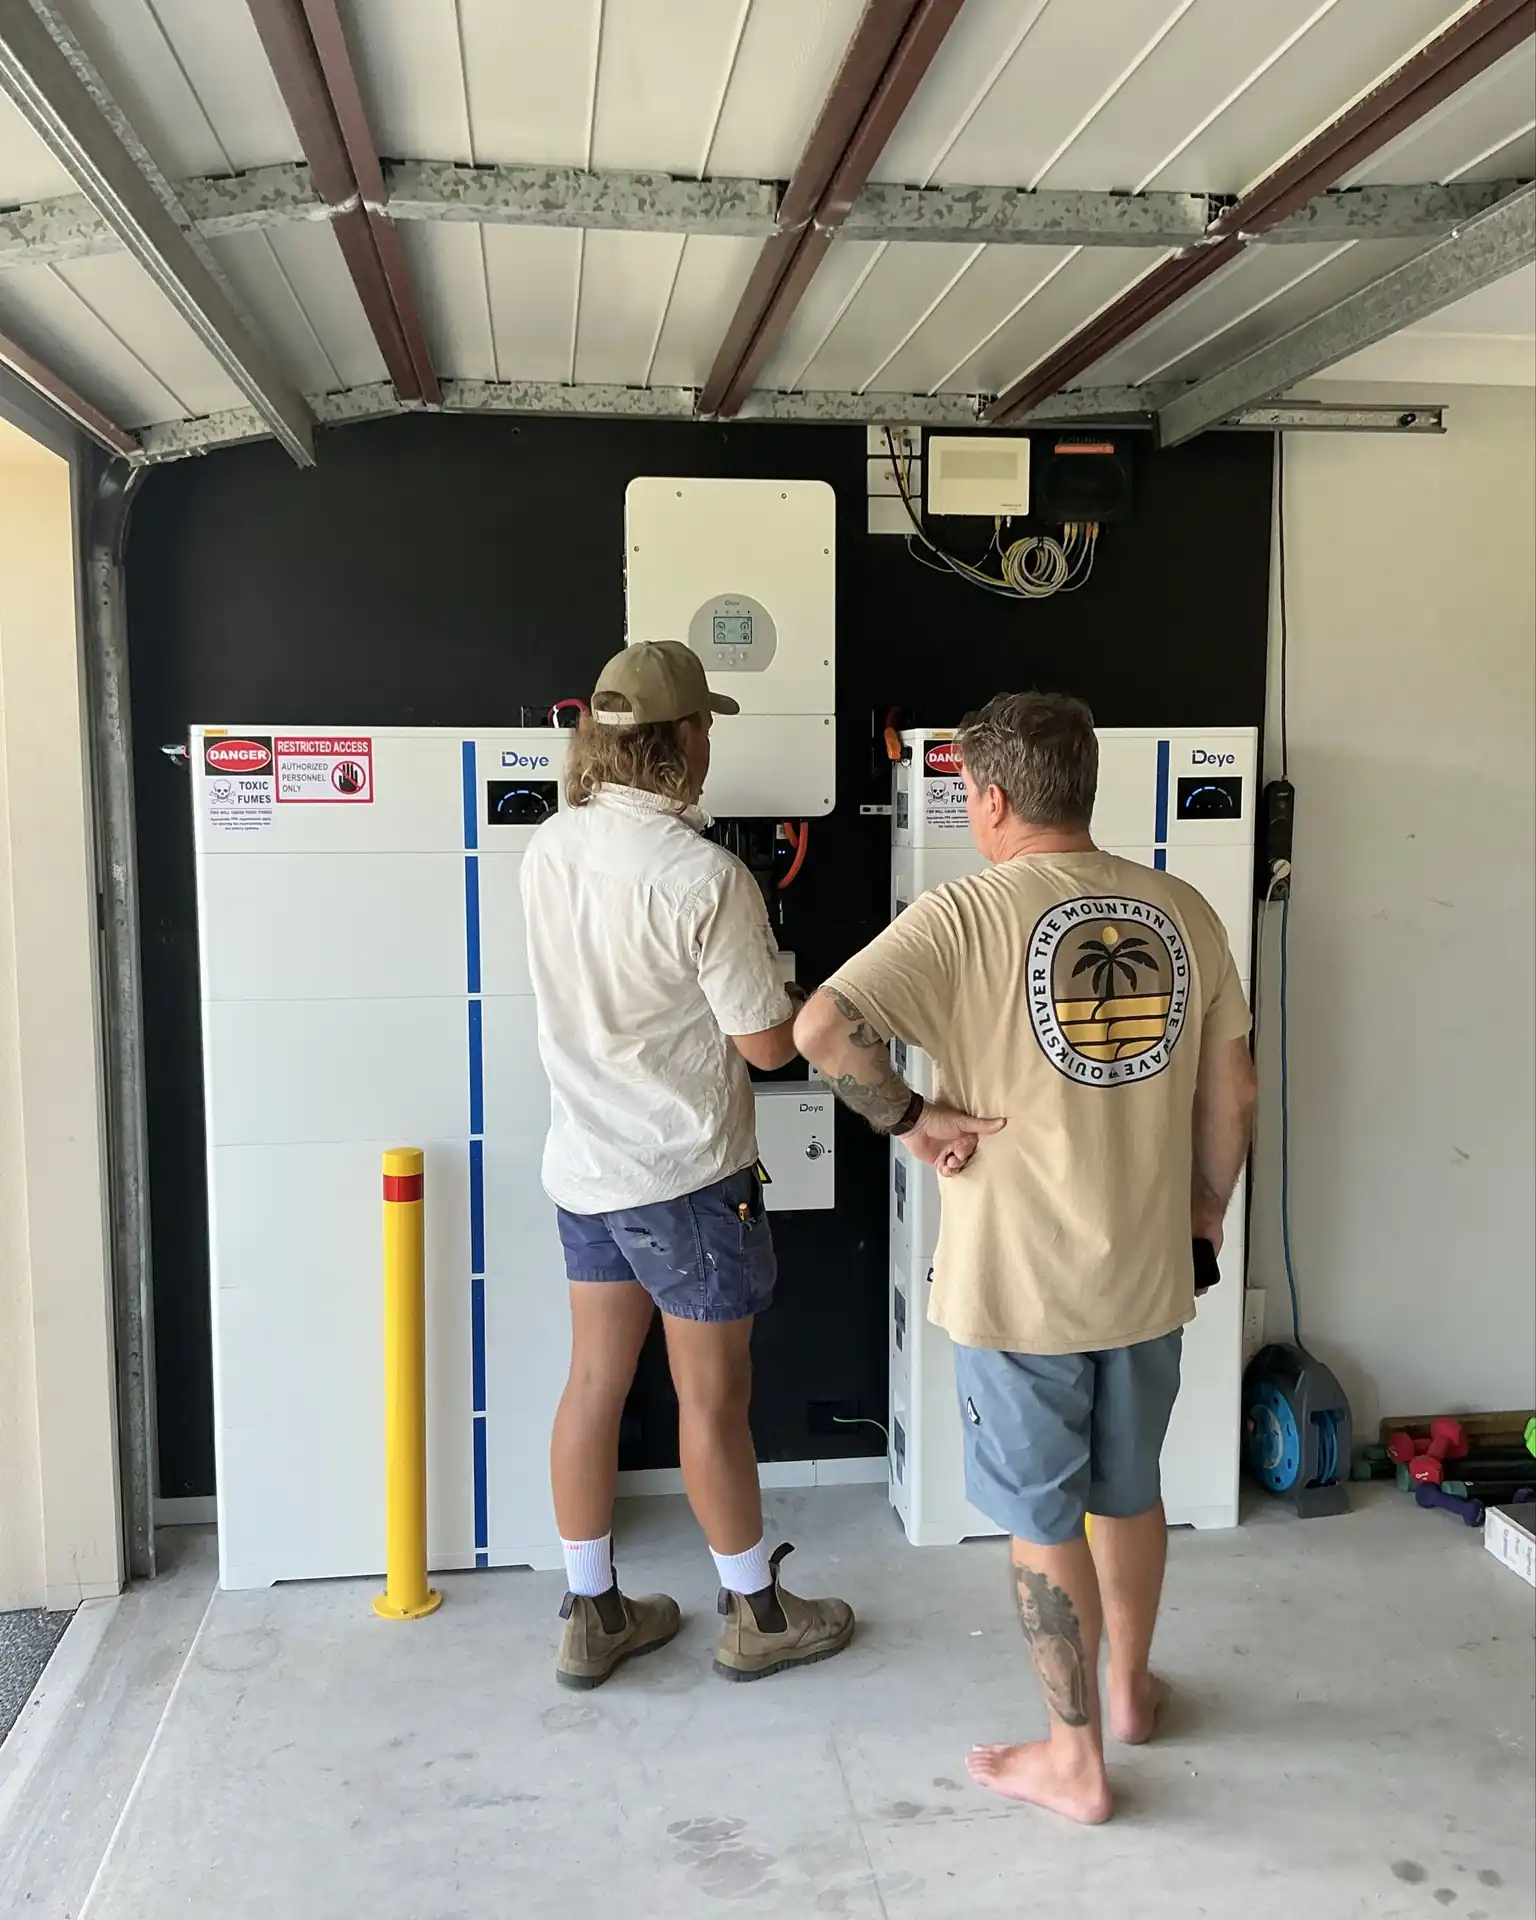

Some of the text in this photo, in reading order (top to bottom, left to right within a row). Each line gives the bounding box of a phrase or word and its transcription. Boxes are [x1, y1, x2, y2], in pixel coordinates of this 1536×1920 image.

[277, 740, 369, 753] RESTRICTED ACCESS
[210, 749, 268, 760] DANGER
[501, 751, 549, 770] Deye
[929, 752, 964, 763] DANG
[1192, 750, 1235, 768] Deye
[281, 762, 329, 771] AUTHORIZED
[282, 774, 327, 782] PERSONNEL
[238, 781, 269, 790] TOXIC
[282, 784, 302, 793] ONLY
[237, 794, 272, 804] FUMES
[950, 794, 969, 804] FUM
[1061, 902, 1166, 929] MOUNTAIN
[1034, 919, 1062, 958] THE
[1166, 934, 1186, 977] AND
[1168, 986, 1186, 1028] THE
[1032, 968, 1103, 1080] QUIKSILVER
